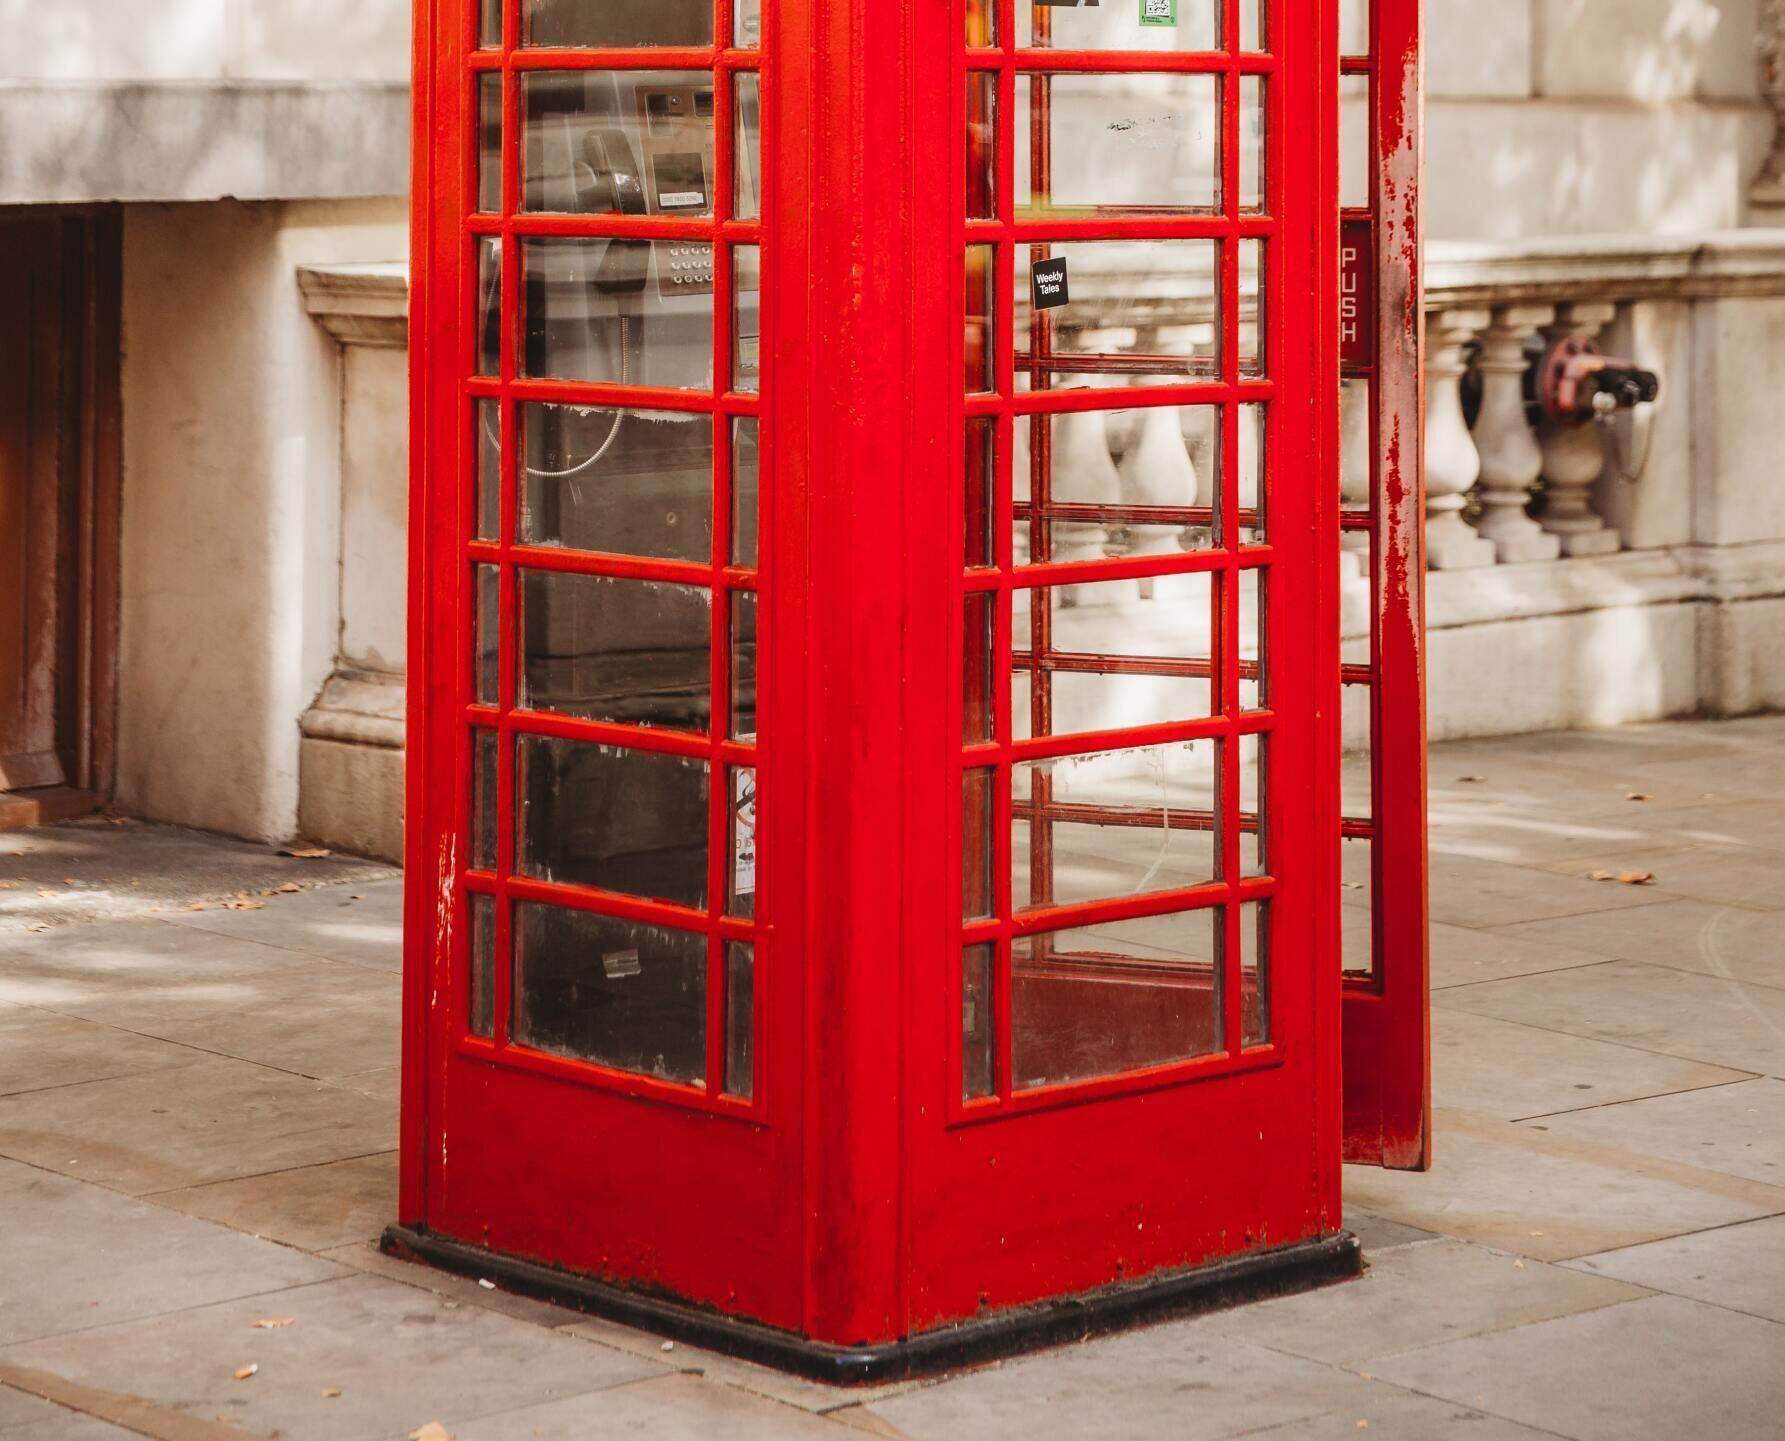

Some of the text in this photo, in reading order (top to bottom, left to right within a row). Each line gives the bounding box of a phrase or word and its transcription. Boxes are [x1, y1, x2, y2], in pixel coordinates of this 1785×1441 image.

[1035, 270, 1064, 285] Weekly
[1039, 283, 1060, 295] Tales
[1341, 247, 1357, 343] PUSH
